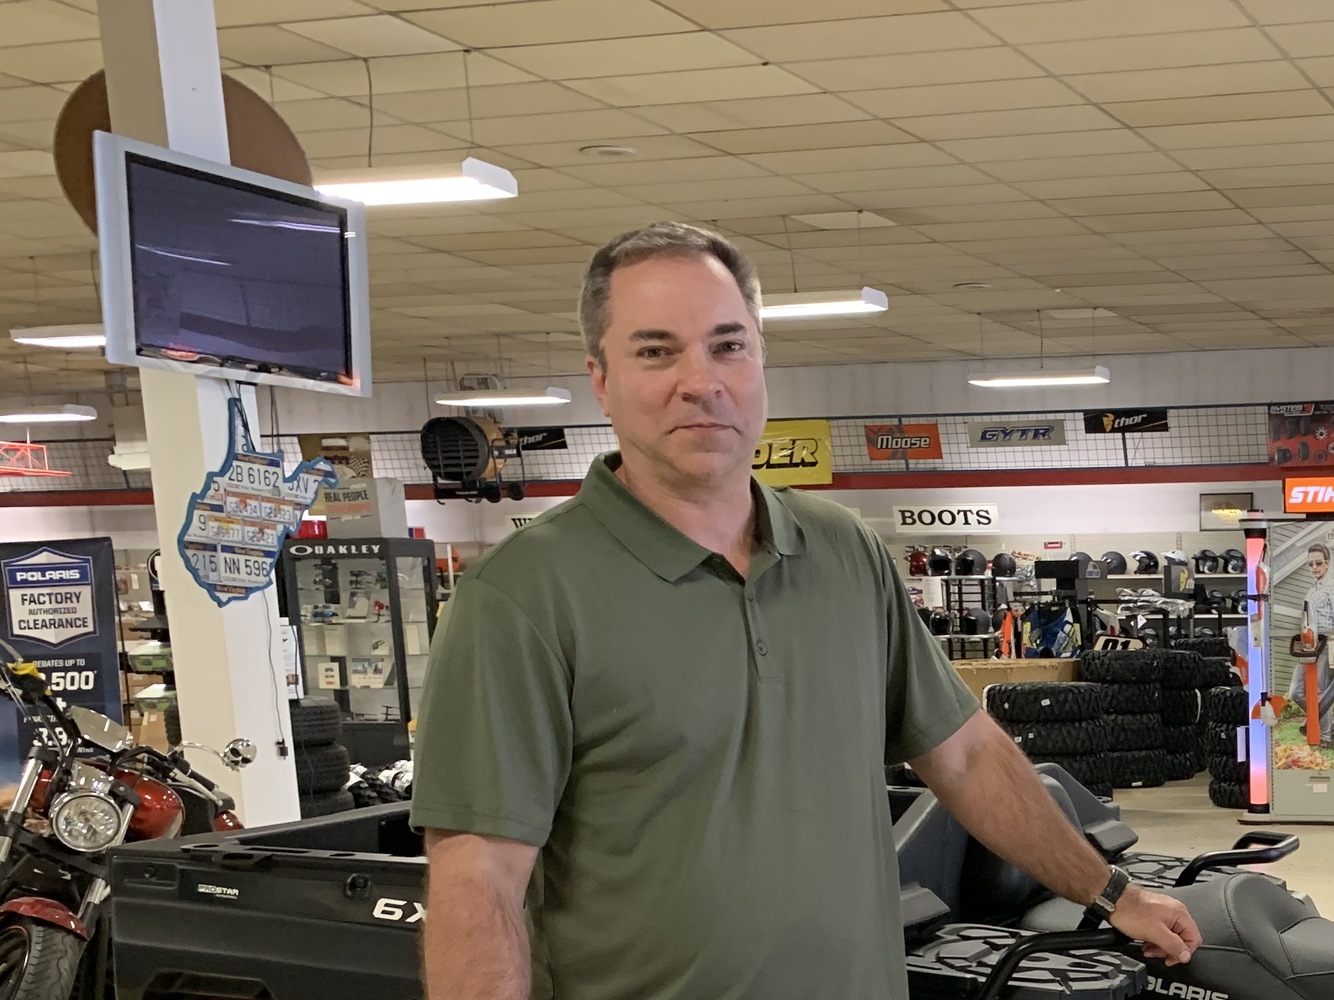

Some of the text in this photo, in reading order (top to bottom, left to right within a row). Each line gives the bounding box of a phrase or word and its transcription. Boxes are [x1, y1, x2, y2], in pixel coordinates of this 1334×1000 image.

[1113, 413, 1148, 428] thor
[980, 425, 1054, 442] GYTR
[876, 434, 931, 450] Moose
[752, 438, 819, 470] DER
[247, 467, 280, 488] 6162
[898, 508, 992, 527] BOOTS
[314, 544, 381, 555] OAKLEY
[224, 556, 241, 575] NN
[16, 569, 80, 581] POLARIS
[20, 591, 82, 606] FACTORY
[28, 607, 77, 616] AUTHORIZED
[18, 617, 89, 630] CLEARANCE
[65, 659, 75, 667] UP
[76, 658, 86, 666] TO
[198, 884, 239, 896] PROSTAR
[372, 898, 428, 923] 6X
